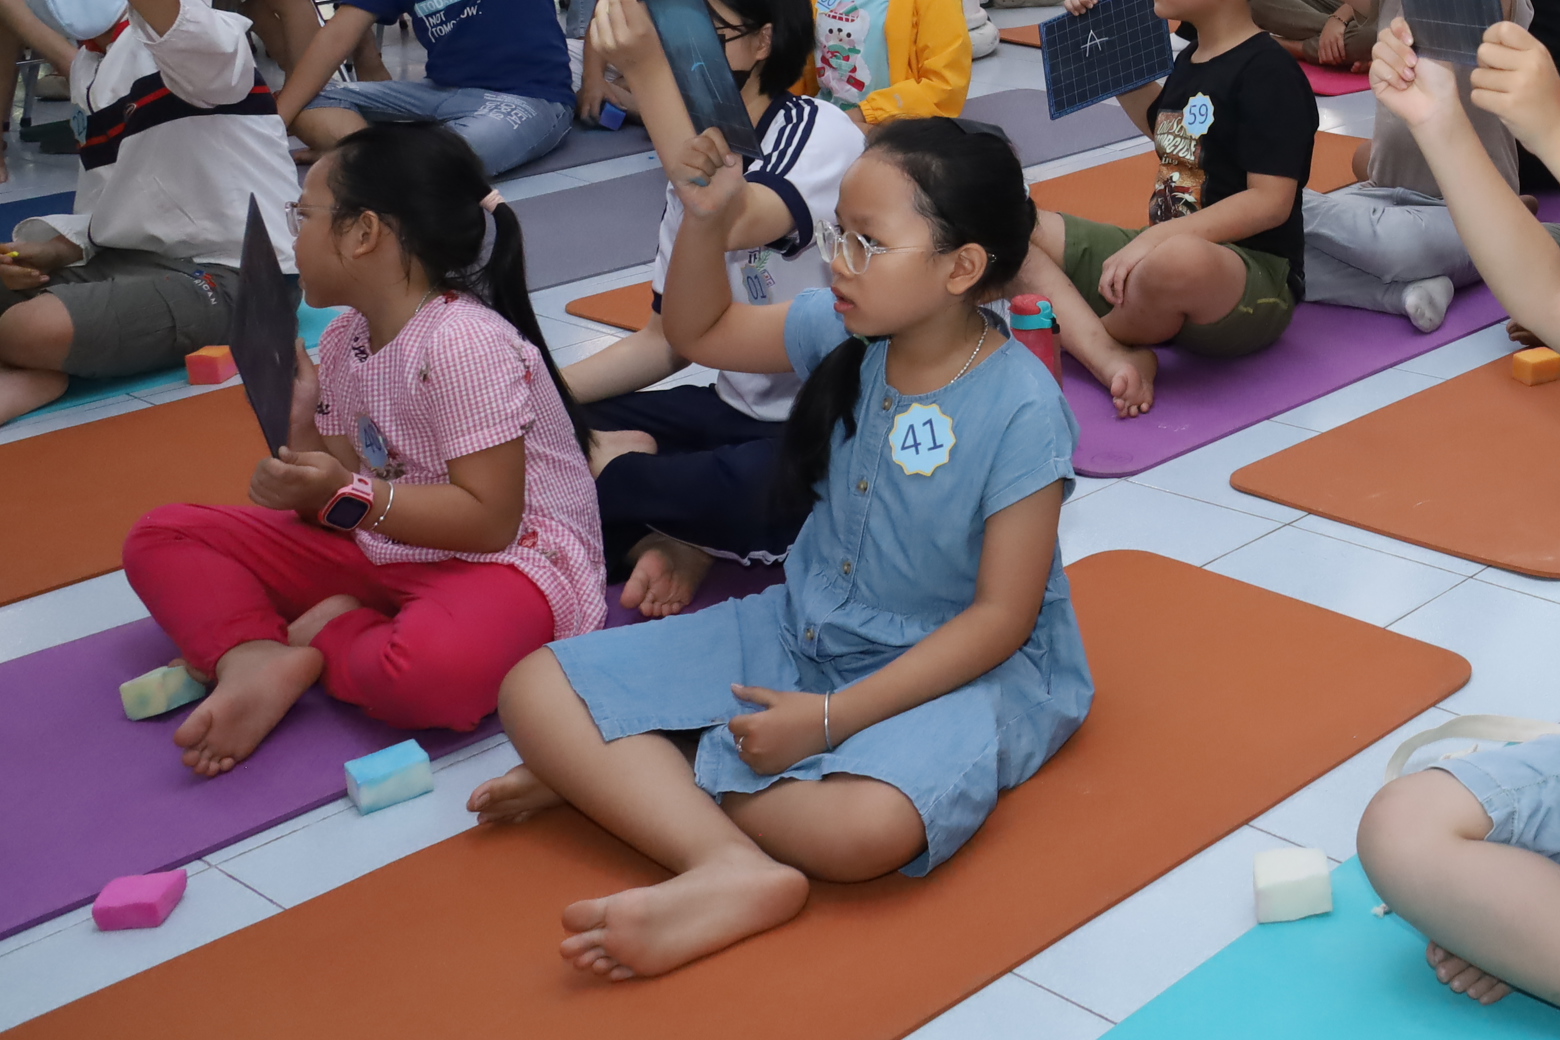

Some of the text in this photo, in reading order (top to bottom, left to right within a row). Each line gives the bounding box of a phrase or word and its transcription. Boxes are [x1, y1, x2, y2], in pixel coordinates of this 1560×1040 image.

[428, 10, 446, 27] NOT
[1080, 29, 1109, 58] A
[1188, 103, 1209, 125] 59
[746, 274, 766, 300] 01
[901, 417, 943, 455] 41
